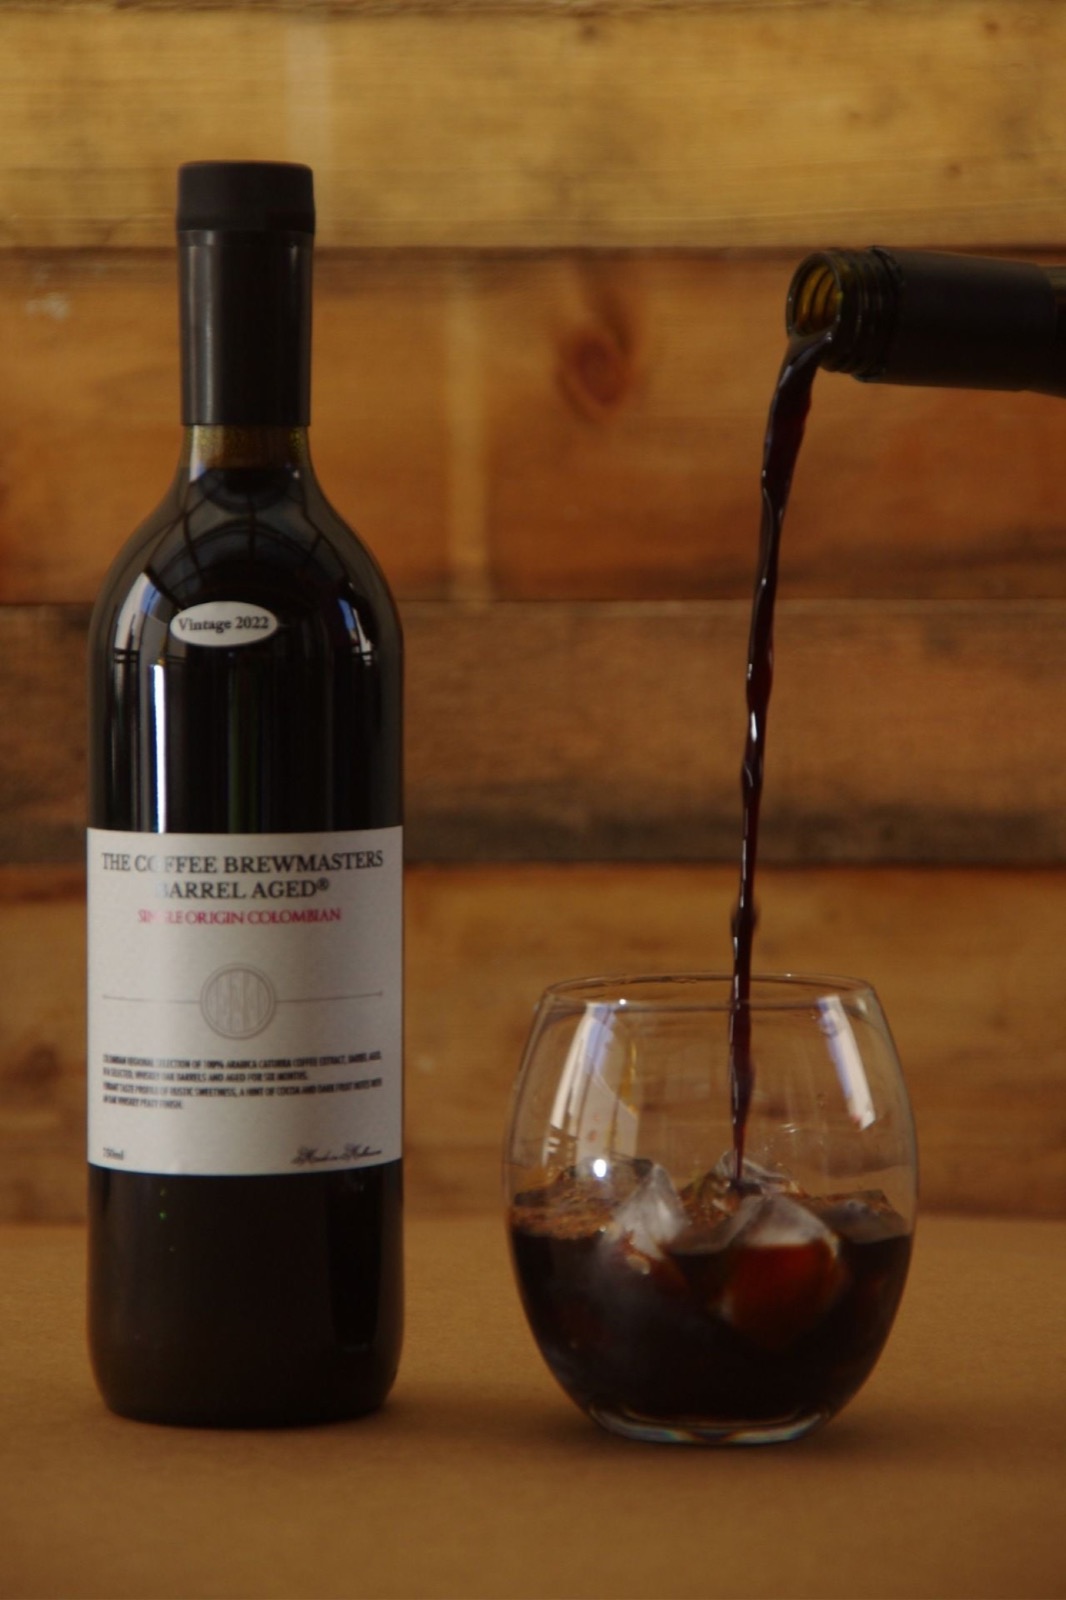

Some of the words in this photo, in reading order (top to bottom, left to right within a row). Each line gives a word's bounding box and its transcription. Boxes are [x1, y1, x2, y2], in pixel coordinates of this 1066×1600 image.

[178, 618, 232, 634] Vintage
[234, 615, 269, 629] 2022
[102, 853, 130, 871] THE
[223, 850, 383, 874] BREWMASTERS
[137, 909, 183, 925] SINLE
[185, 911, 244, 925] ORIGIN
[247, 908, 343, 924] COLOMBIAN
[226, 1059, 257, 1070] ARABICA
[293, 1057, 317, 1067] COFFEE
[177, 1073, 206, 1083] BARRELS
[208, 1073, 224, 1083] AND
[225, 1072, 246, 1083] AGED
[247, 1072, 262, 1082] FOR
[276, 1085, 300, 1096] COCOA
